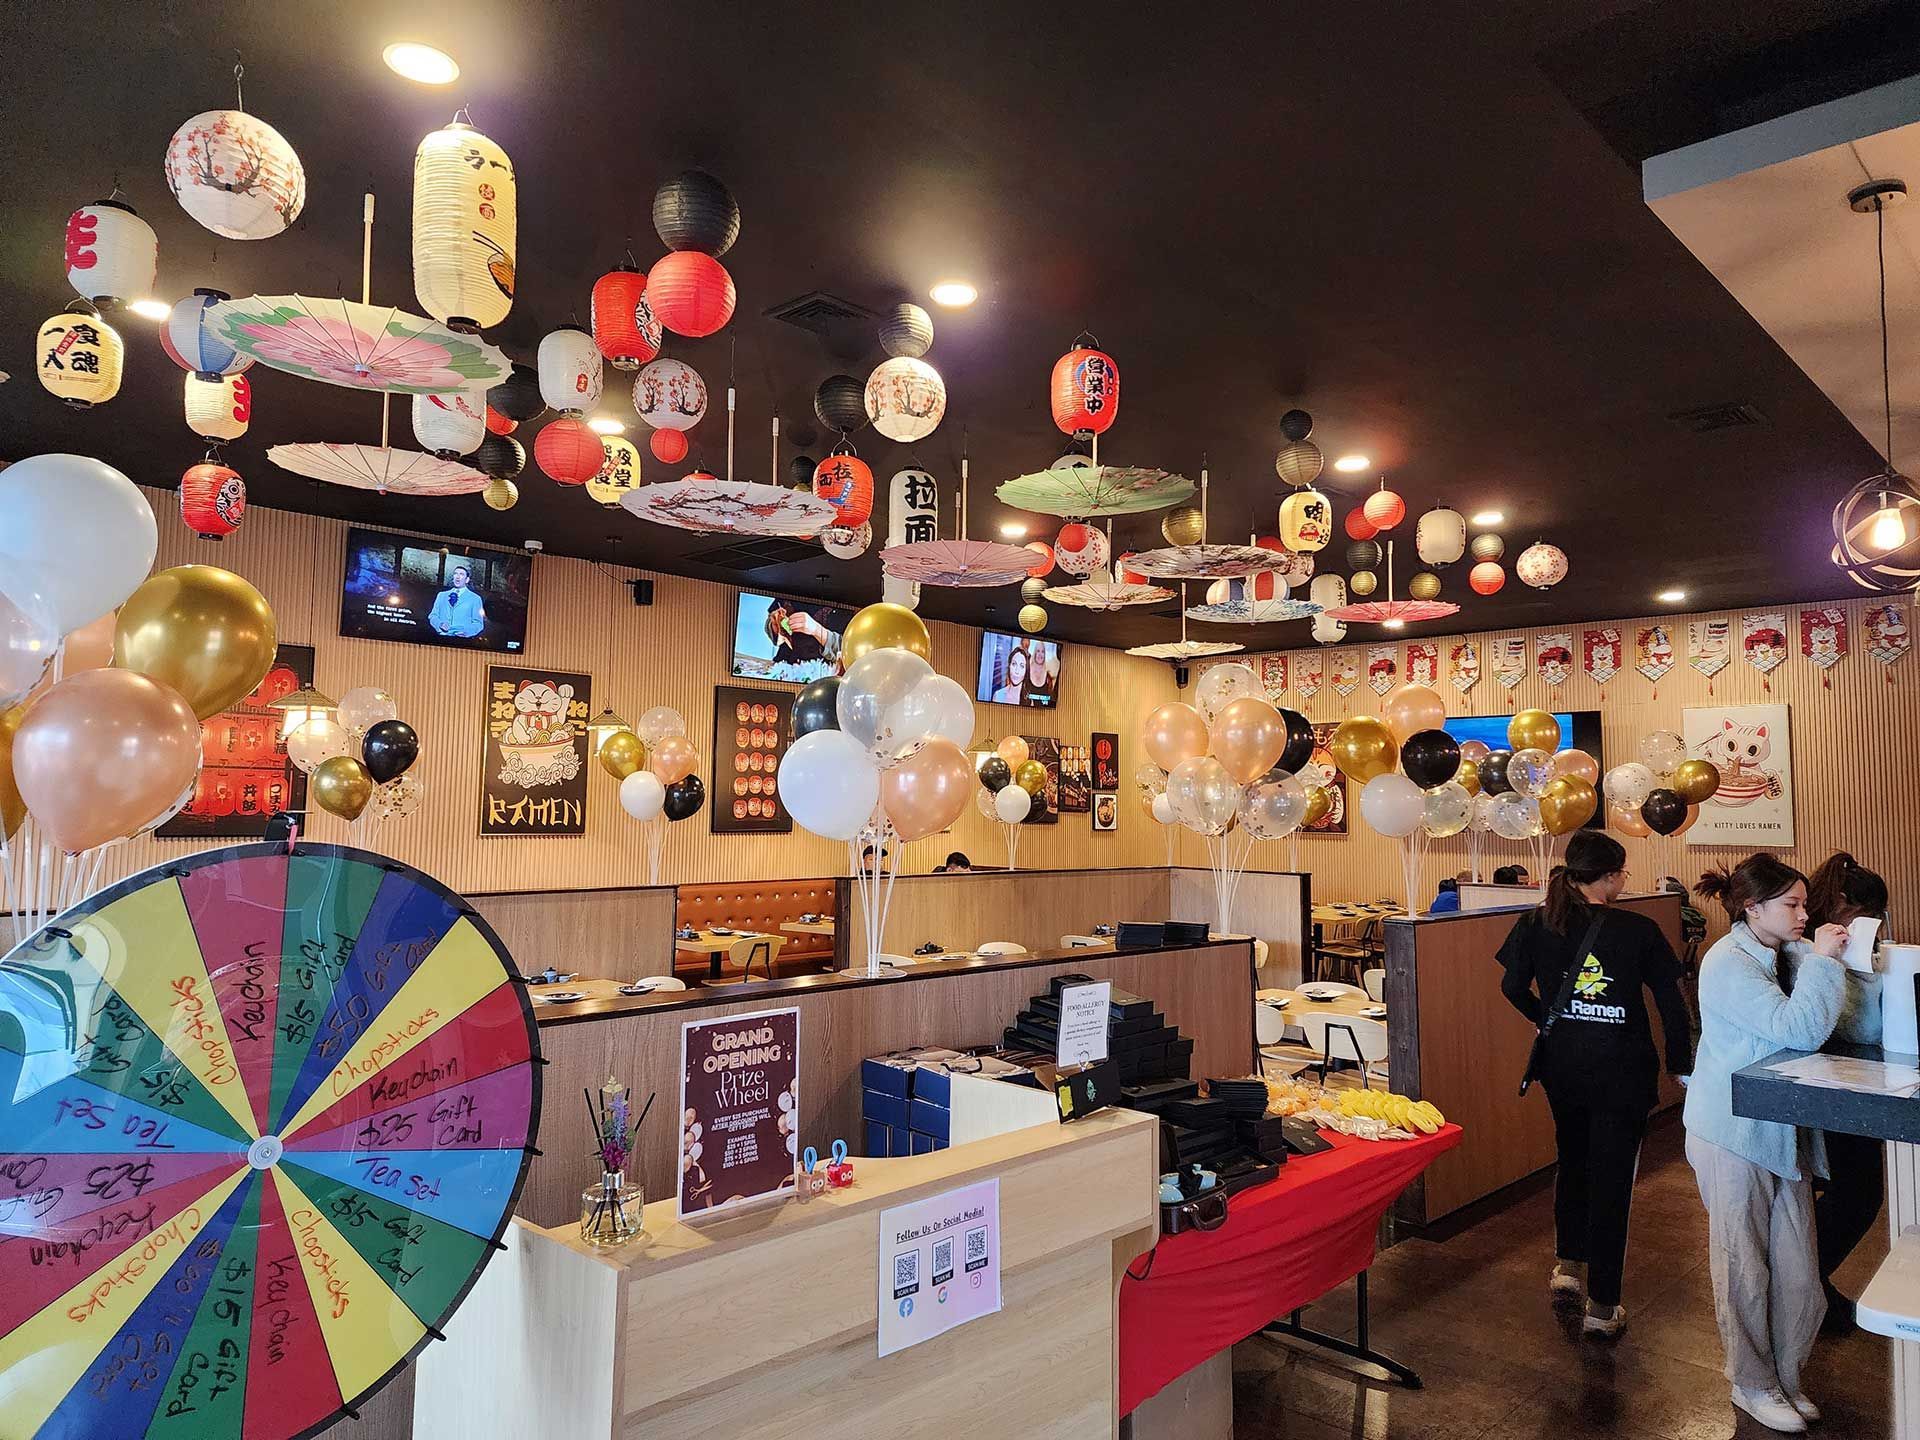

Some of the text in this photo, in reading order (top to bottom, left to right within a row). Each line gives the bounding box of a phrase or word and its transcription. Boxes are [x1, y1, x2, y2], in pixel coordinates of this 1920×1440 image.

[490, 681, 516, 738] まねき
[567, 700, 589, 737] ねこ
[488, 793, 581, 826] RAMEN
[323, 932, 356, 983] Card
[230, 941, 275, 1042] Keychain
[279, 939, 327, 1045] $15 Gift
[1067, 1000, 1105, 1012] FOOD ALLERGY
[1077, 1009, 1095, 1017] NOTICE
[1571, 1000, 1625, 1018] Ramen
[170, 976, 237, 1084] Chopsticks
[712, 1027, 774, 1051] GRAND
[333, 1008, 439, 1097] Chopsticks
[703, 1044, 781, 1073] OPENING
[369, 1057, 457, 1109] Keychain
[715, 1081, 769, 1109] Wheel
[721, 1070, 765, 1090] Prize
[54, 1098, 175, 1148] Tea Set
[358, 1095, 478, 1152] $25 Gift
[439, 1120, 482, 1146] Card
[715, 1115, 731, 1123] EVERY
[742, 1107, 768, 1118] PURCHASE
[83, 1157, 155, 1200] $25
[356, 1157, 441, 1202] Tea Set
[30, 1202, 157, 1266] Keychain
[331, 1194, 426, 1245] $15 Gift
[896, 1205, 984, 1242] Follow Us On Social Media!
[66, 1208, 201, 1323] Chopsticks
[291, 1210, 350, 1319] Chopsticks
[377, 1248, 423, 1286] Card
[967, 1262, 979, 1271] SCAN
[896, 1285, 916, 1297] SCAN ME
[209, 1257, 252, 1402] $15 Gift
[165, 1352, 209, 1418] Card
